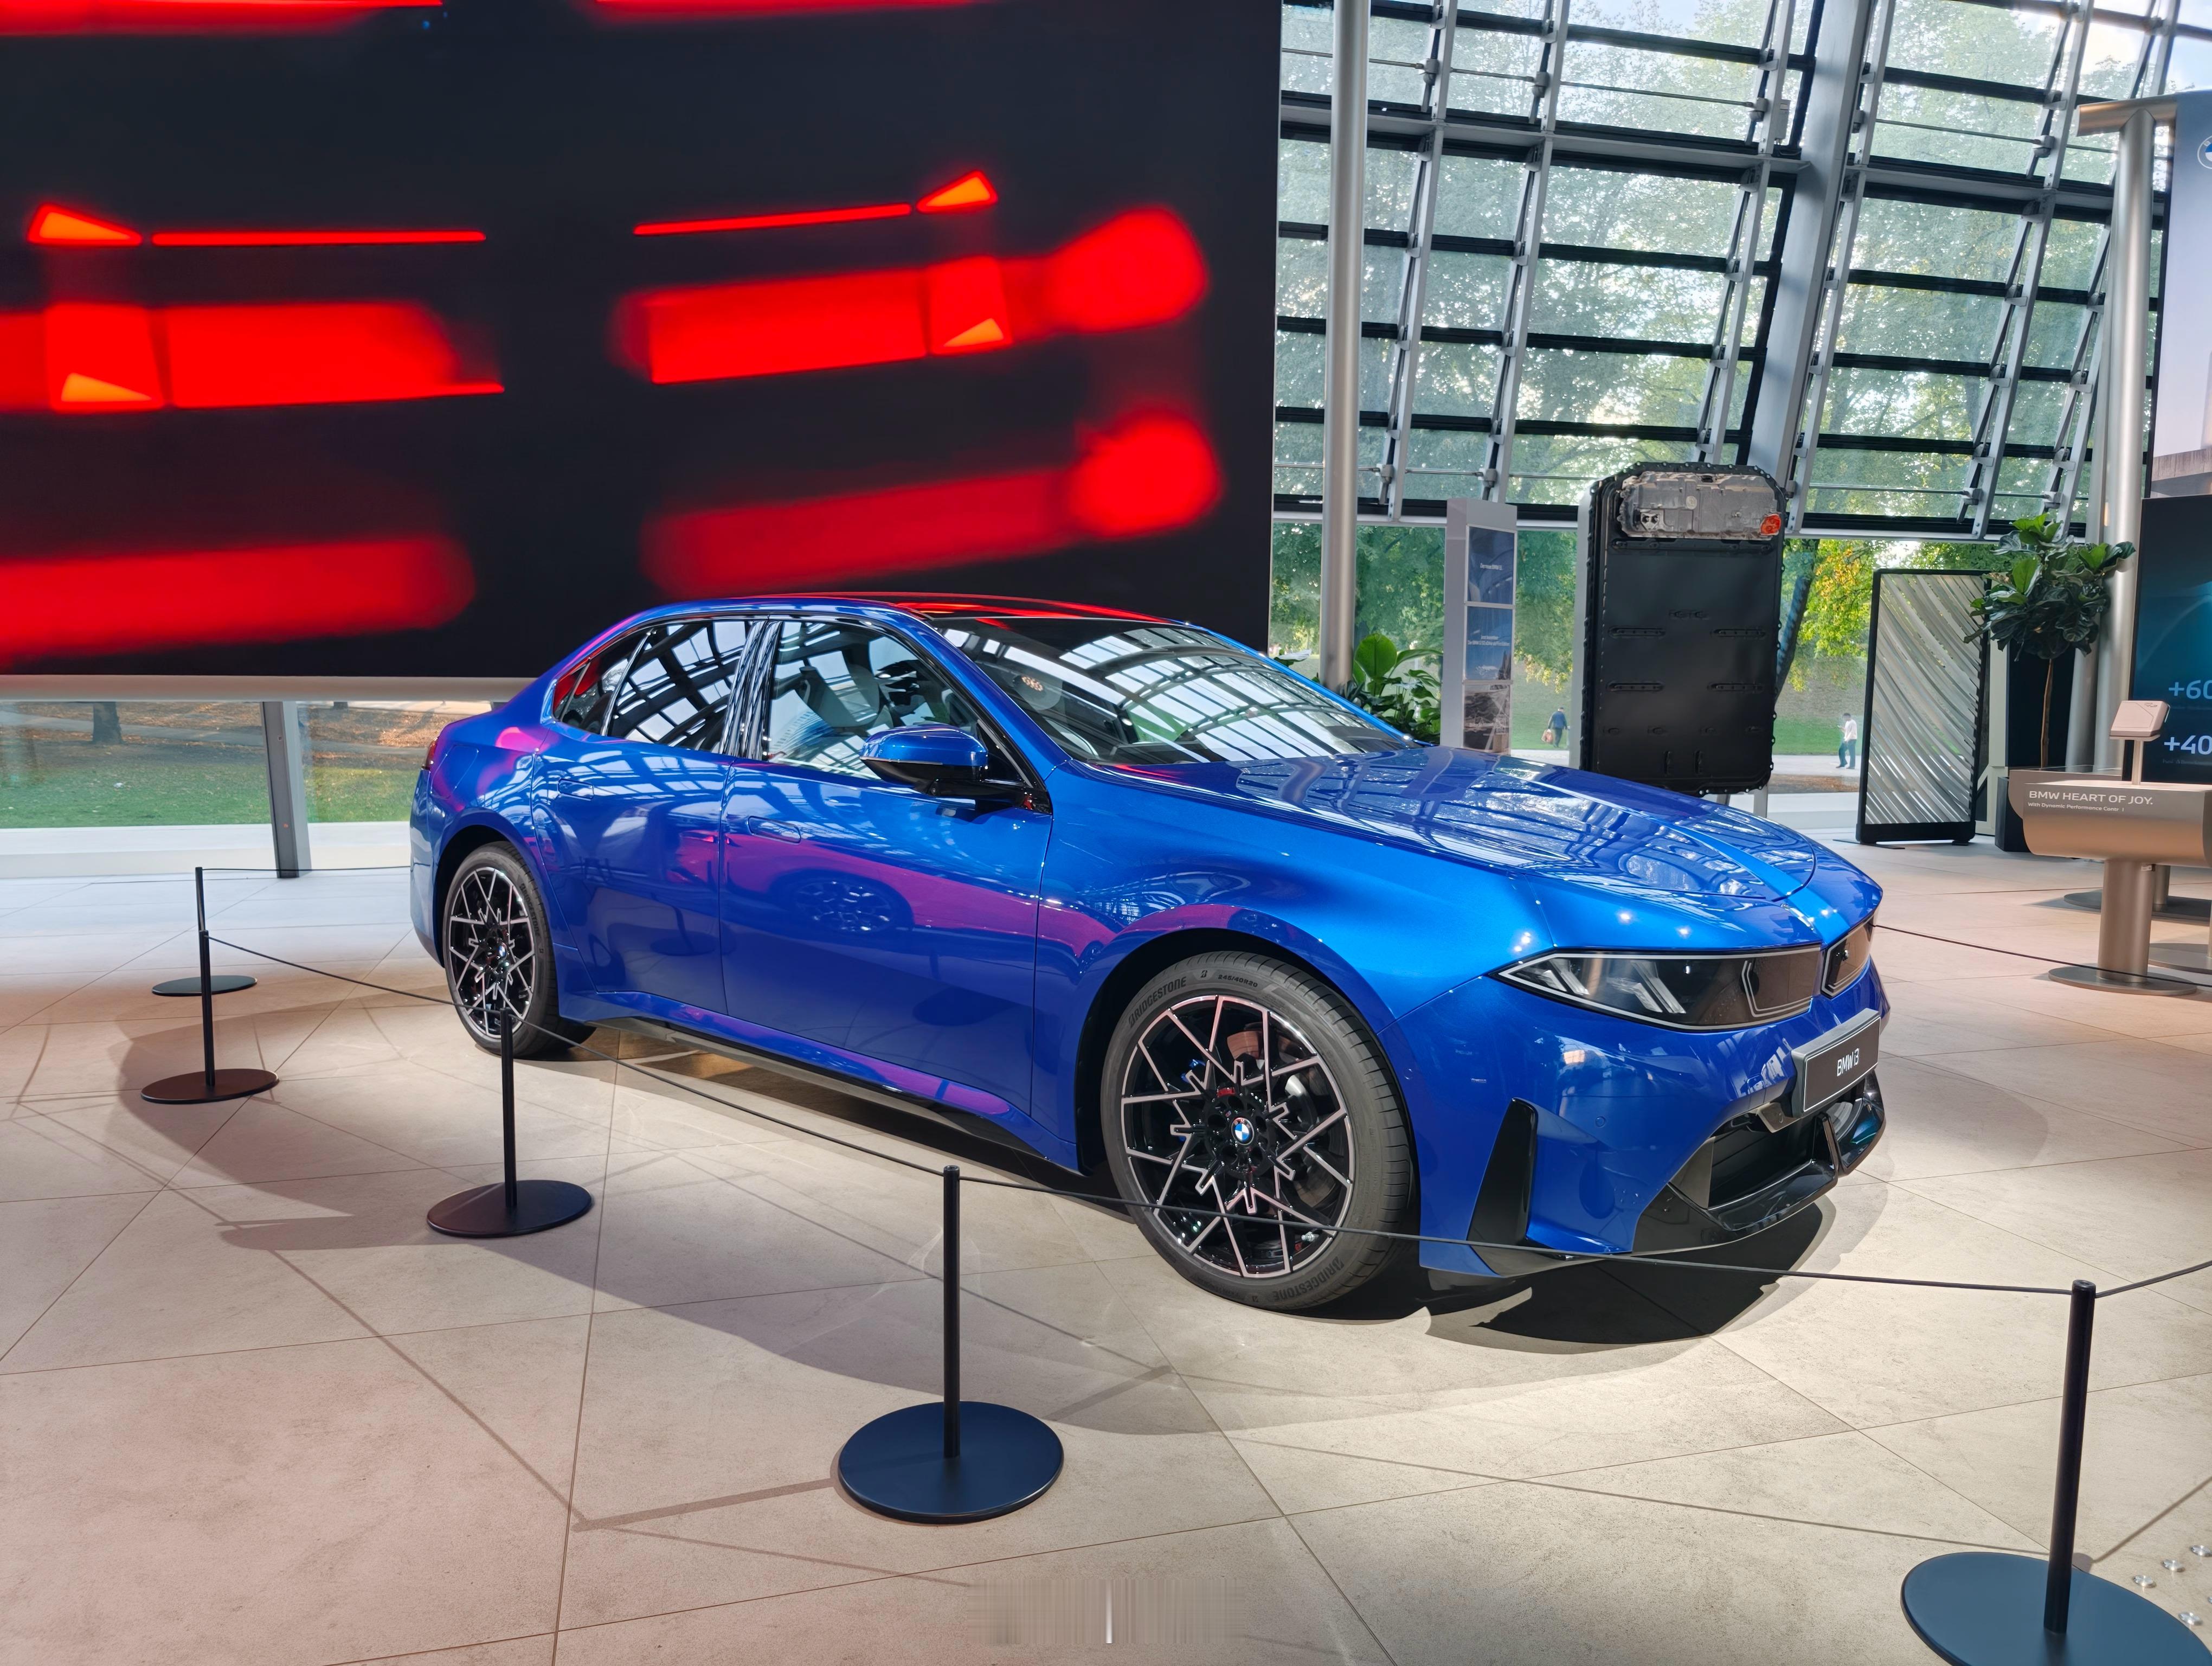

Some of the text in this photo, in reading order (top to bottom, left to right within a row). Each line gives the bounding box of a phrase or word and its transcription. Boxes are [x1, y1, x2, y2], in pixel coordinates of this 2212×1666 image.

[2169, 680, 2212, 699] +60
[2164, 735, 2212, 755] +40
[2029, 791, 2153, 805] BMW HEART OF JOY.
[1218, 974, 1258, 988] 245/40R20
[1128, 976, 1187, 1028] BRIDGESTONE
[1837, 1048, 1859, 1077] BMW i3
[1272, 1256, 1345, 1302] BRIDGESTONE
